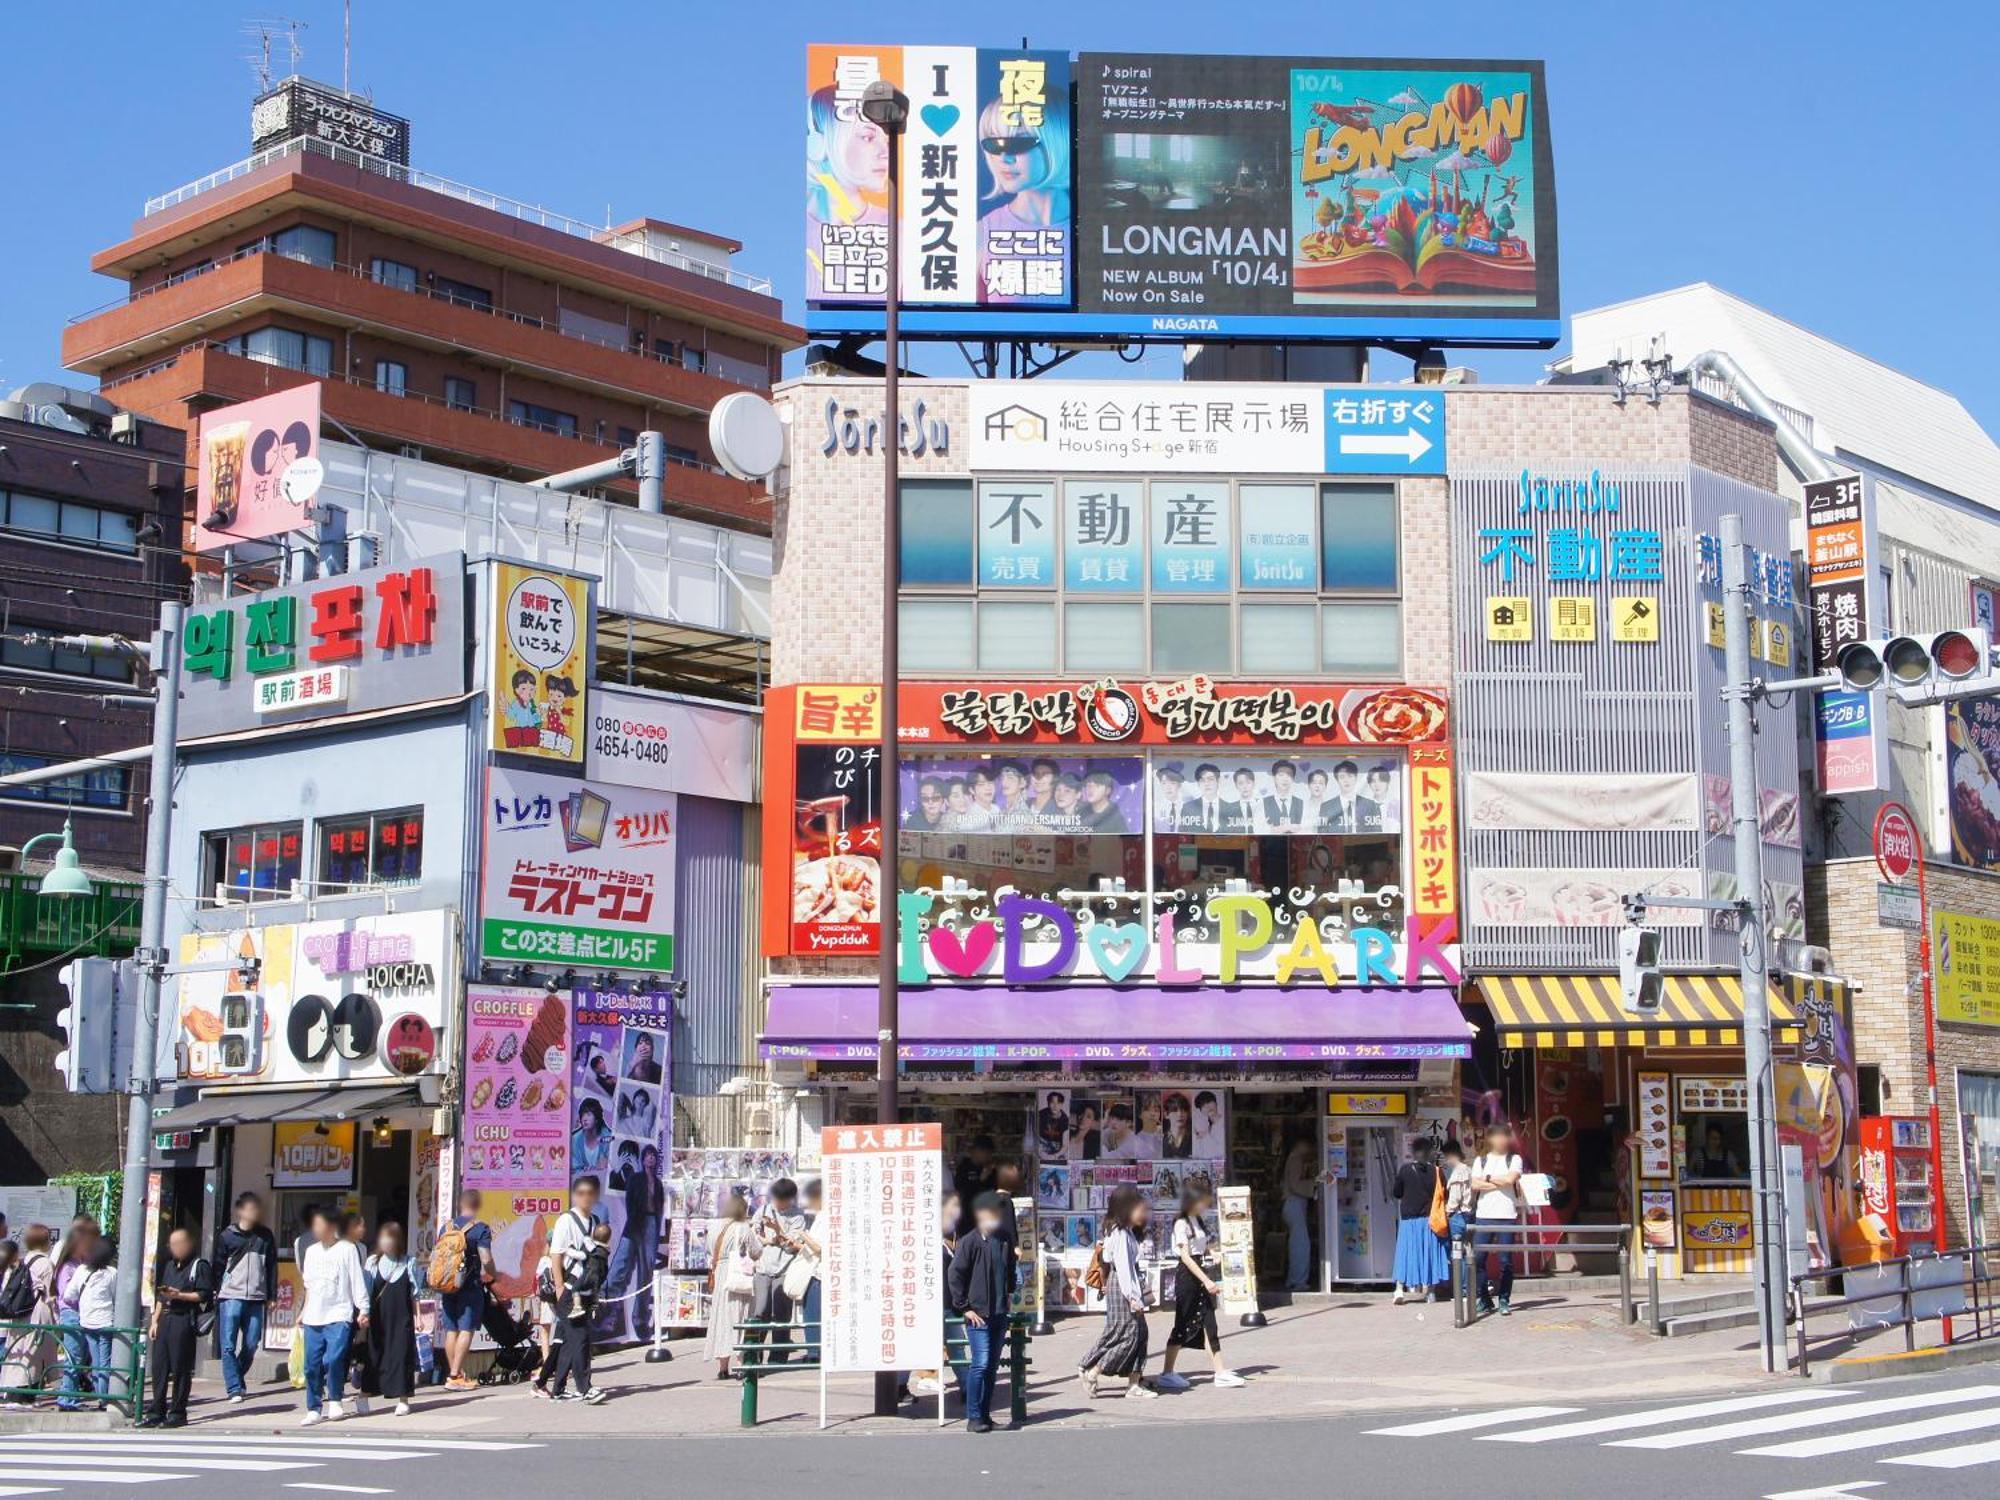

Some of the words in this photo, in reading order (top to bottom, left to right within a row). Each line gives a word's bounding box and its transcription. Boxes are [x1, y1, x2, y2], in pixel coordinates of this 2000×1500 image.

[932, 64, 950, 98] I
[1000, 60, 1047, 104] 夜
[1114, 67, 1153, 81] spiral
[1297, 73, 1344, 93] 10/4
[1102, 84, 1149, 97] TVアニメ
[1000, 104, 1045, 127] でも
[1102, 110, 1185, 121] オープニングテーマ
[316, 120, 386, 157] 新大久保
[1301, 91, 1527, 187] LONGMAN
[920, 144, 959, 292] 新大久保
[987, 229, 1065, 256] ここに
[1102, 225, 1287, 257] LONGMAN
[823, 246, 889, 267] 目立つ
[822, 265, 888, 294] LED
[985, 258, 1064, 297] 爆誕
[1103, 270, 1140, 284] NEW
[1145, 271, 1204, 285] ALBUM
[1102, 288, 1137, 303] Now
[1143, 289, 1165, 303] On
[1170, 289, 1204, 304] Sale
[1152, 318, 1219, 332] NAGATA
[1059, 400, 1310, 434] 総合住宅展示場
[1332, 398, 1435, 425] 右折すぐ
[1188, 439, 1218, 455] 新宿
[1834, 482, 1861, 505] 3F
[988, 493, 1218, 547] 不動産
[991, 556, 1041, 581] 売買
[1478, 526, 1665, 584] 不動産
[1079, 557, 1130, 583] 賃貸
[1166, 558, 1216, 582] 管理
[520, 590, 564, 614] 駅前で
[183, 567, 437, 681] 역전포차
[519, 611, 563, 634] 飲んで
[1816, 592, 1833, 661] 炭火ホルモン
[1834, 592, 1859, 642] 焼肉
[518, 633, 566, 656] いこうよ。
[261, 671, 333, 706] 駅前酒場
[1145, 676, 1207, 705] 동대문
[595, 716, 621, 733] 080
[800, 690, 875, 737] 旨辛
[941, 691, 1076, 734] 불닭발
[1160, 690, 1333, 740] 엽기떡볶이
[594, 735, 669, 764] 4654-0480
[1413, 749, 1448, 762] チーズ
[494, 794, 552, 824] トレカ
[614, 809, 672, 839] オリパ
[1419, 770, 1449, 906] トッポッキ
[1883, 832, 1911, 858] 消火栓
[515, 859, 654, 887] トレーディングカードショップ
[507, 874, 654, 923] ラストワン
[501, 927, 657, 963] この交差点ビル5F
[1208, 894, 1463, 986] PARK
[364, 963, 429, 988] HOICHA
[473, 999, 534, 1017] CROFFLE
[474, 1124, 511, 1140] ICHU
[837, 1127, 927, 1150] 進入禁止
[514, 1197, 562, 1213] ¥500
[828, 1158, 842, 1318] 車両通行禁止になります
[900, 1155, 917, 1329] 車両通行止めのお知らせ
[921, 1157, 936, 1301] 大久保まつりにともなう
